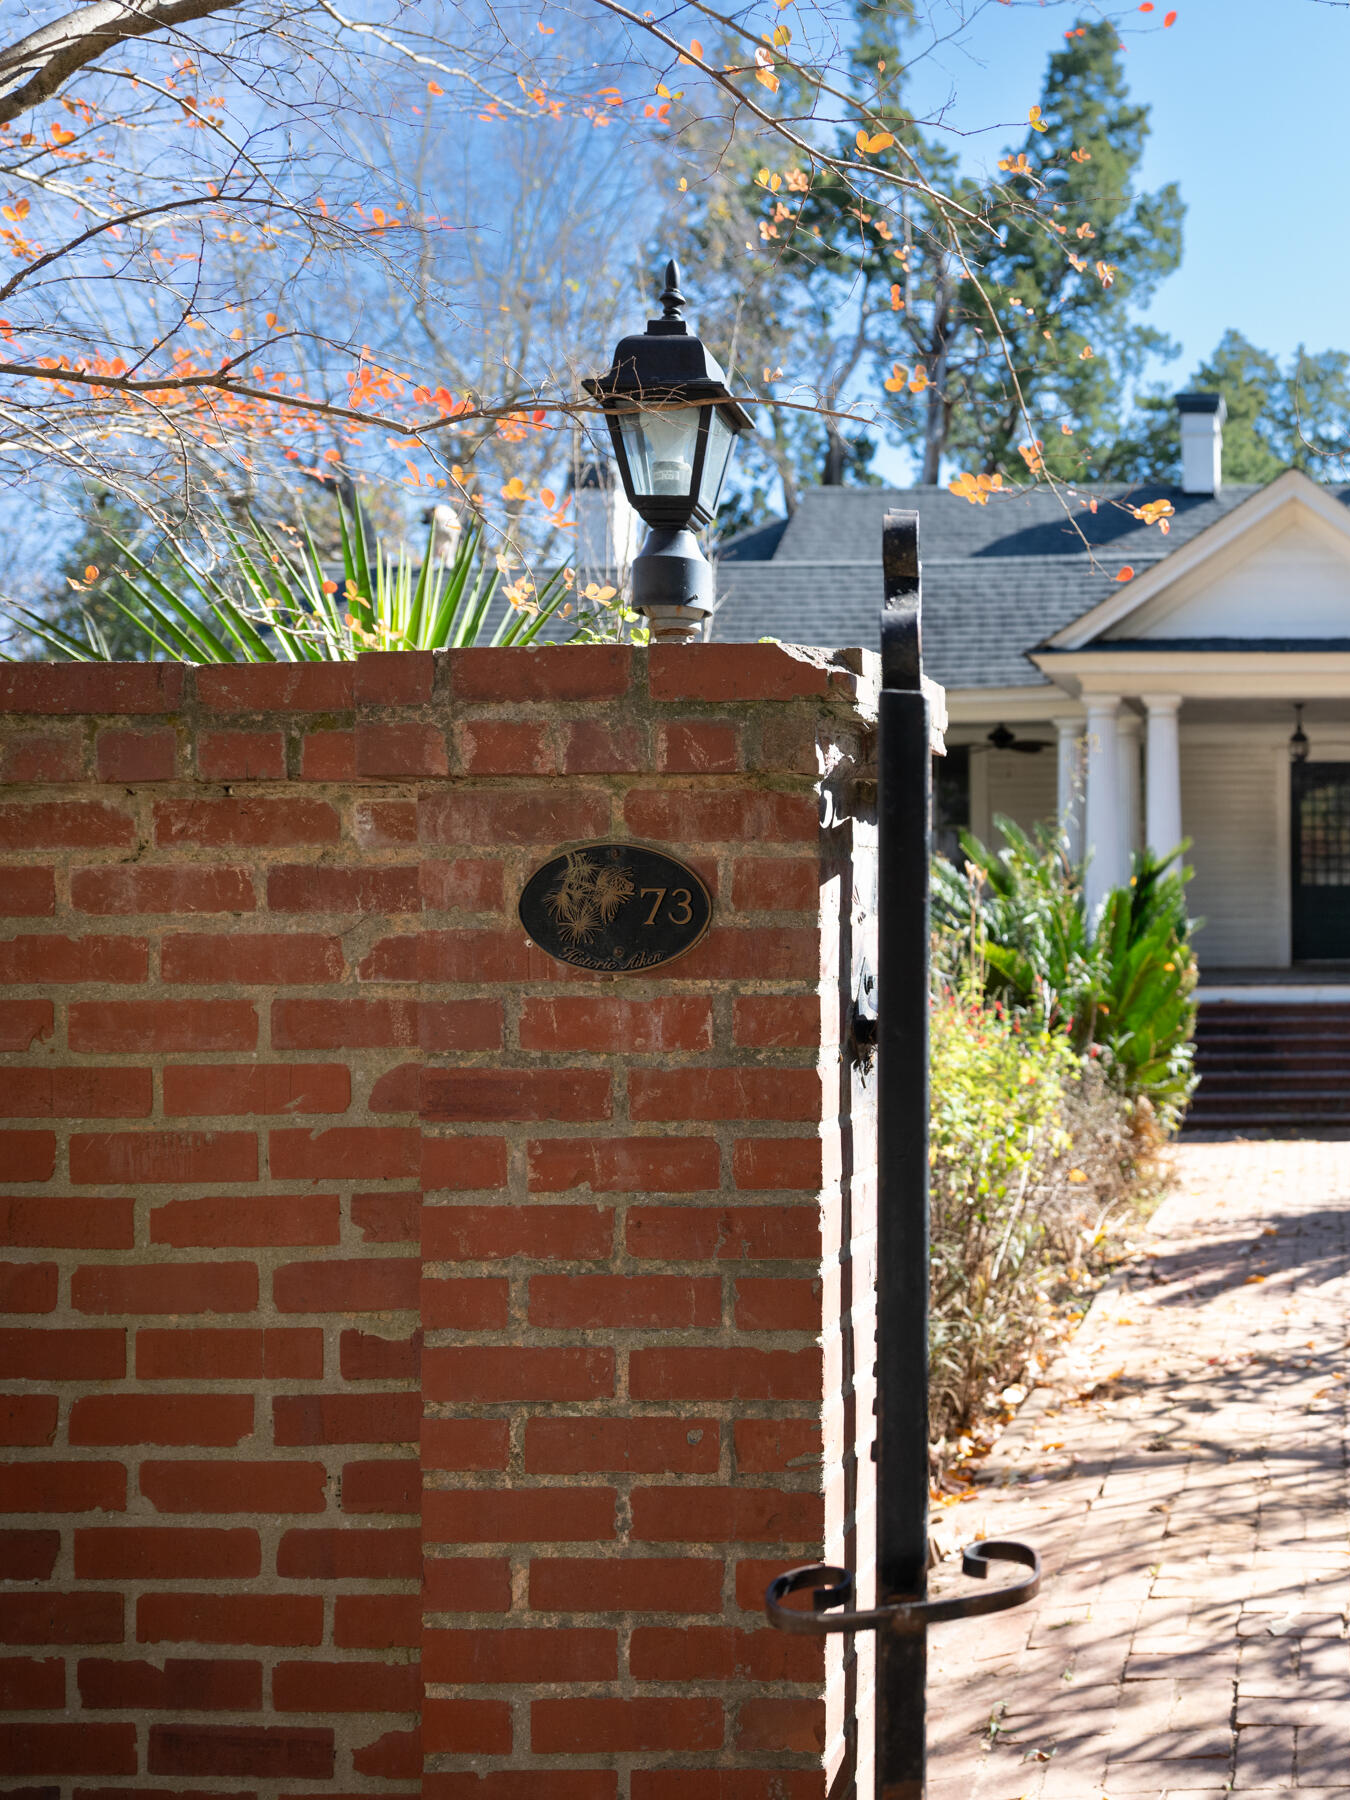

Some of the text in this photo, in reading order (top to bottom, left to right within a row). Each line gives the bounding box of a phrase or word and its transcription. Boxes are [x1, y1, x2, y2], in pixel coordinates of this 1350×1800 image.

[640, 888, 693, 925] 73
[559, 946, 664, 970] Historic Aiken
